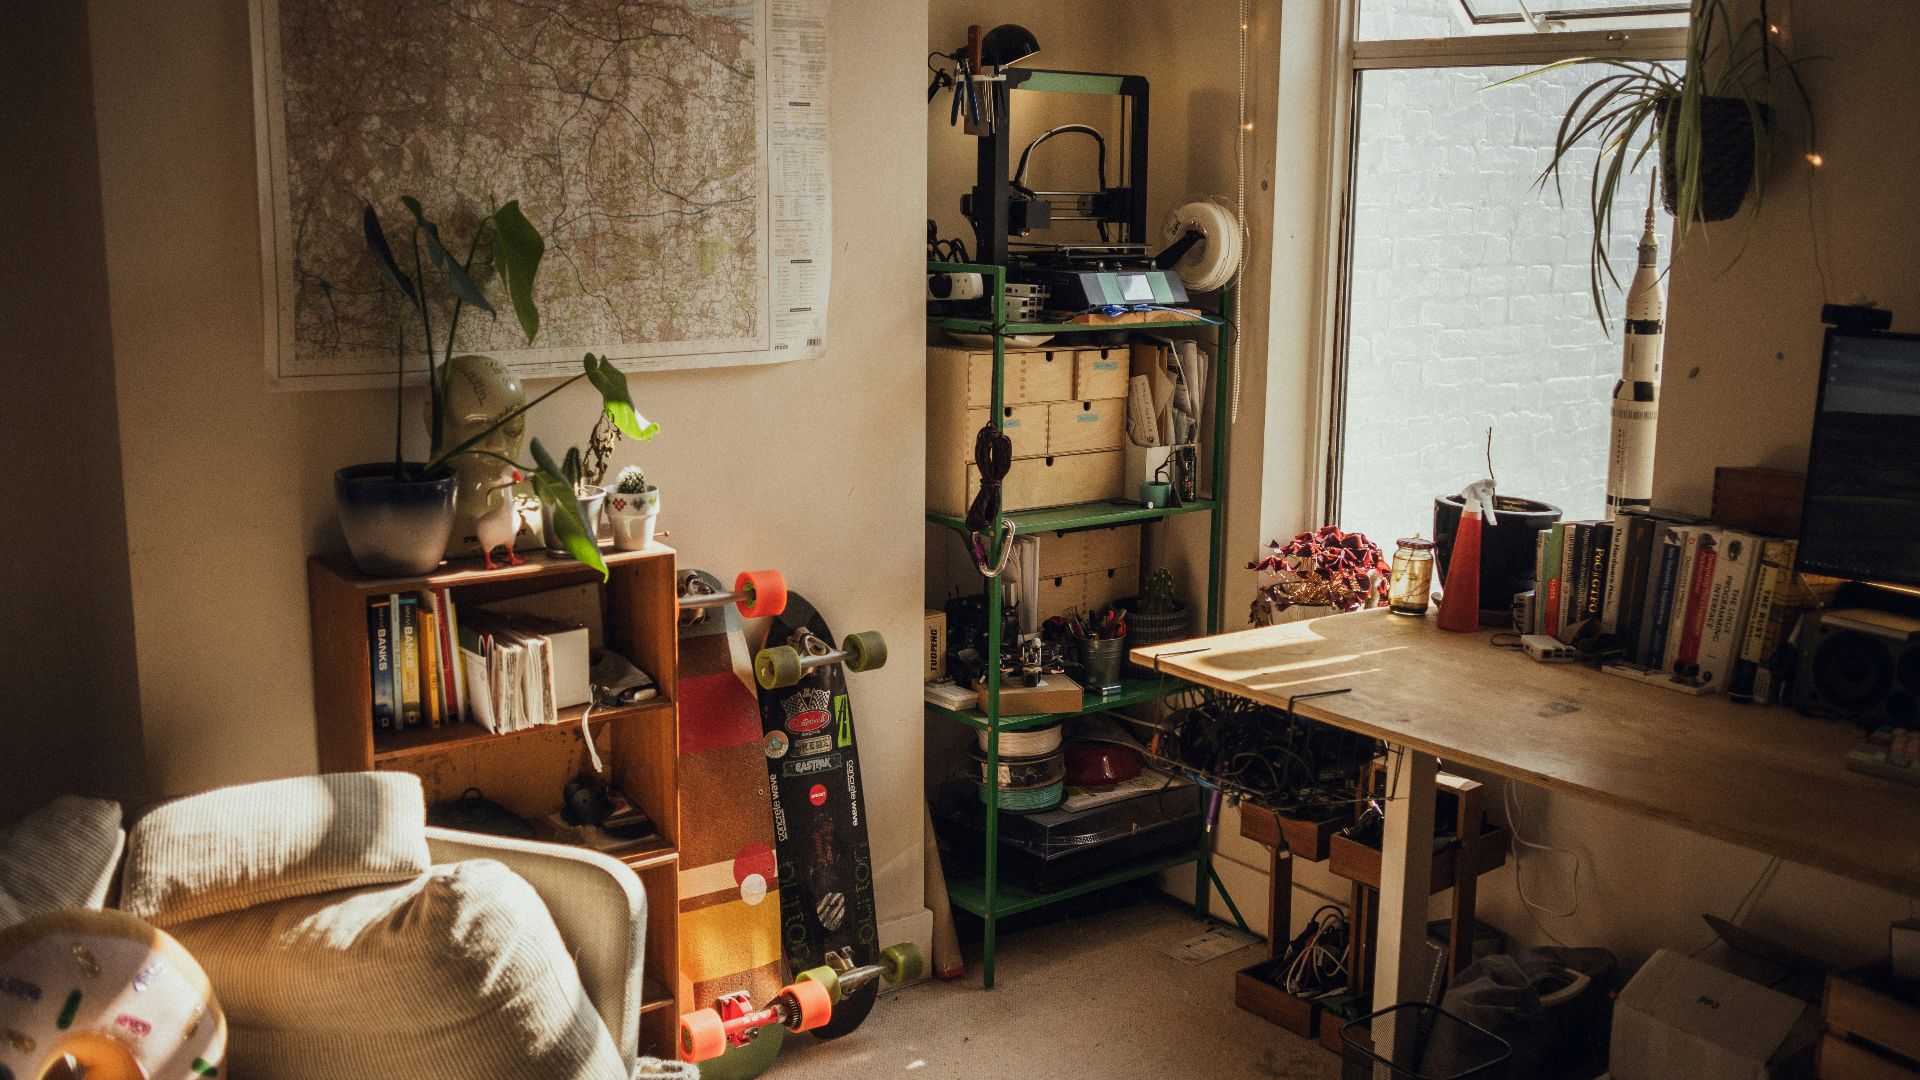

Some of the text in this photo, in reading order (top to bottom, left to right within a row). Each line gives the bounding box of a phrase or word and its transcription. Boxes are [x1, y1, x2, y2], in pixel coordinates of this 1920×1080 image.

[1611, 542, 1620, 583] Hardware
[1707, 584, 1721, 628] INTERFACE
[1713, 575, 1733, 642] PROGRAMMING
[1724, 588, 1740, 633] THE LINUX
[1755, 590, 1771, 639] THE RUST
[377, 628, 388, 671] BANKS
[404, 626, 414, 668] BANKS
[770, 774, 780, 800] wave
[849, 760, 859, 826] concrete wave
[772, 801, 785, 841] concrete
